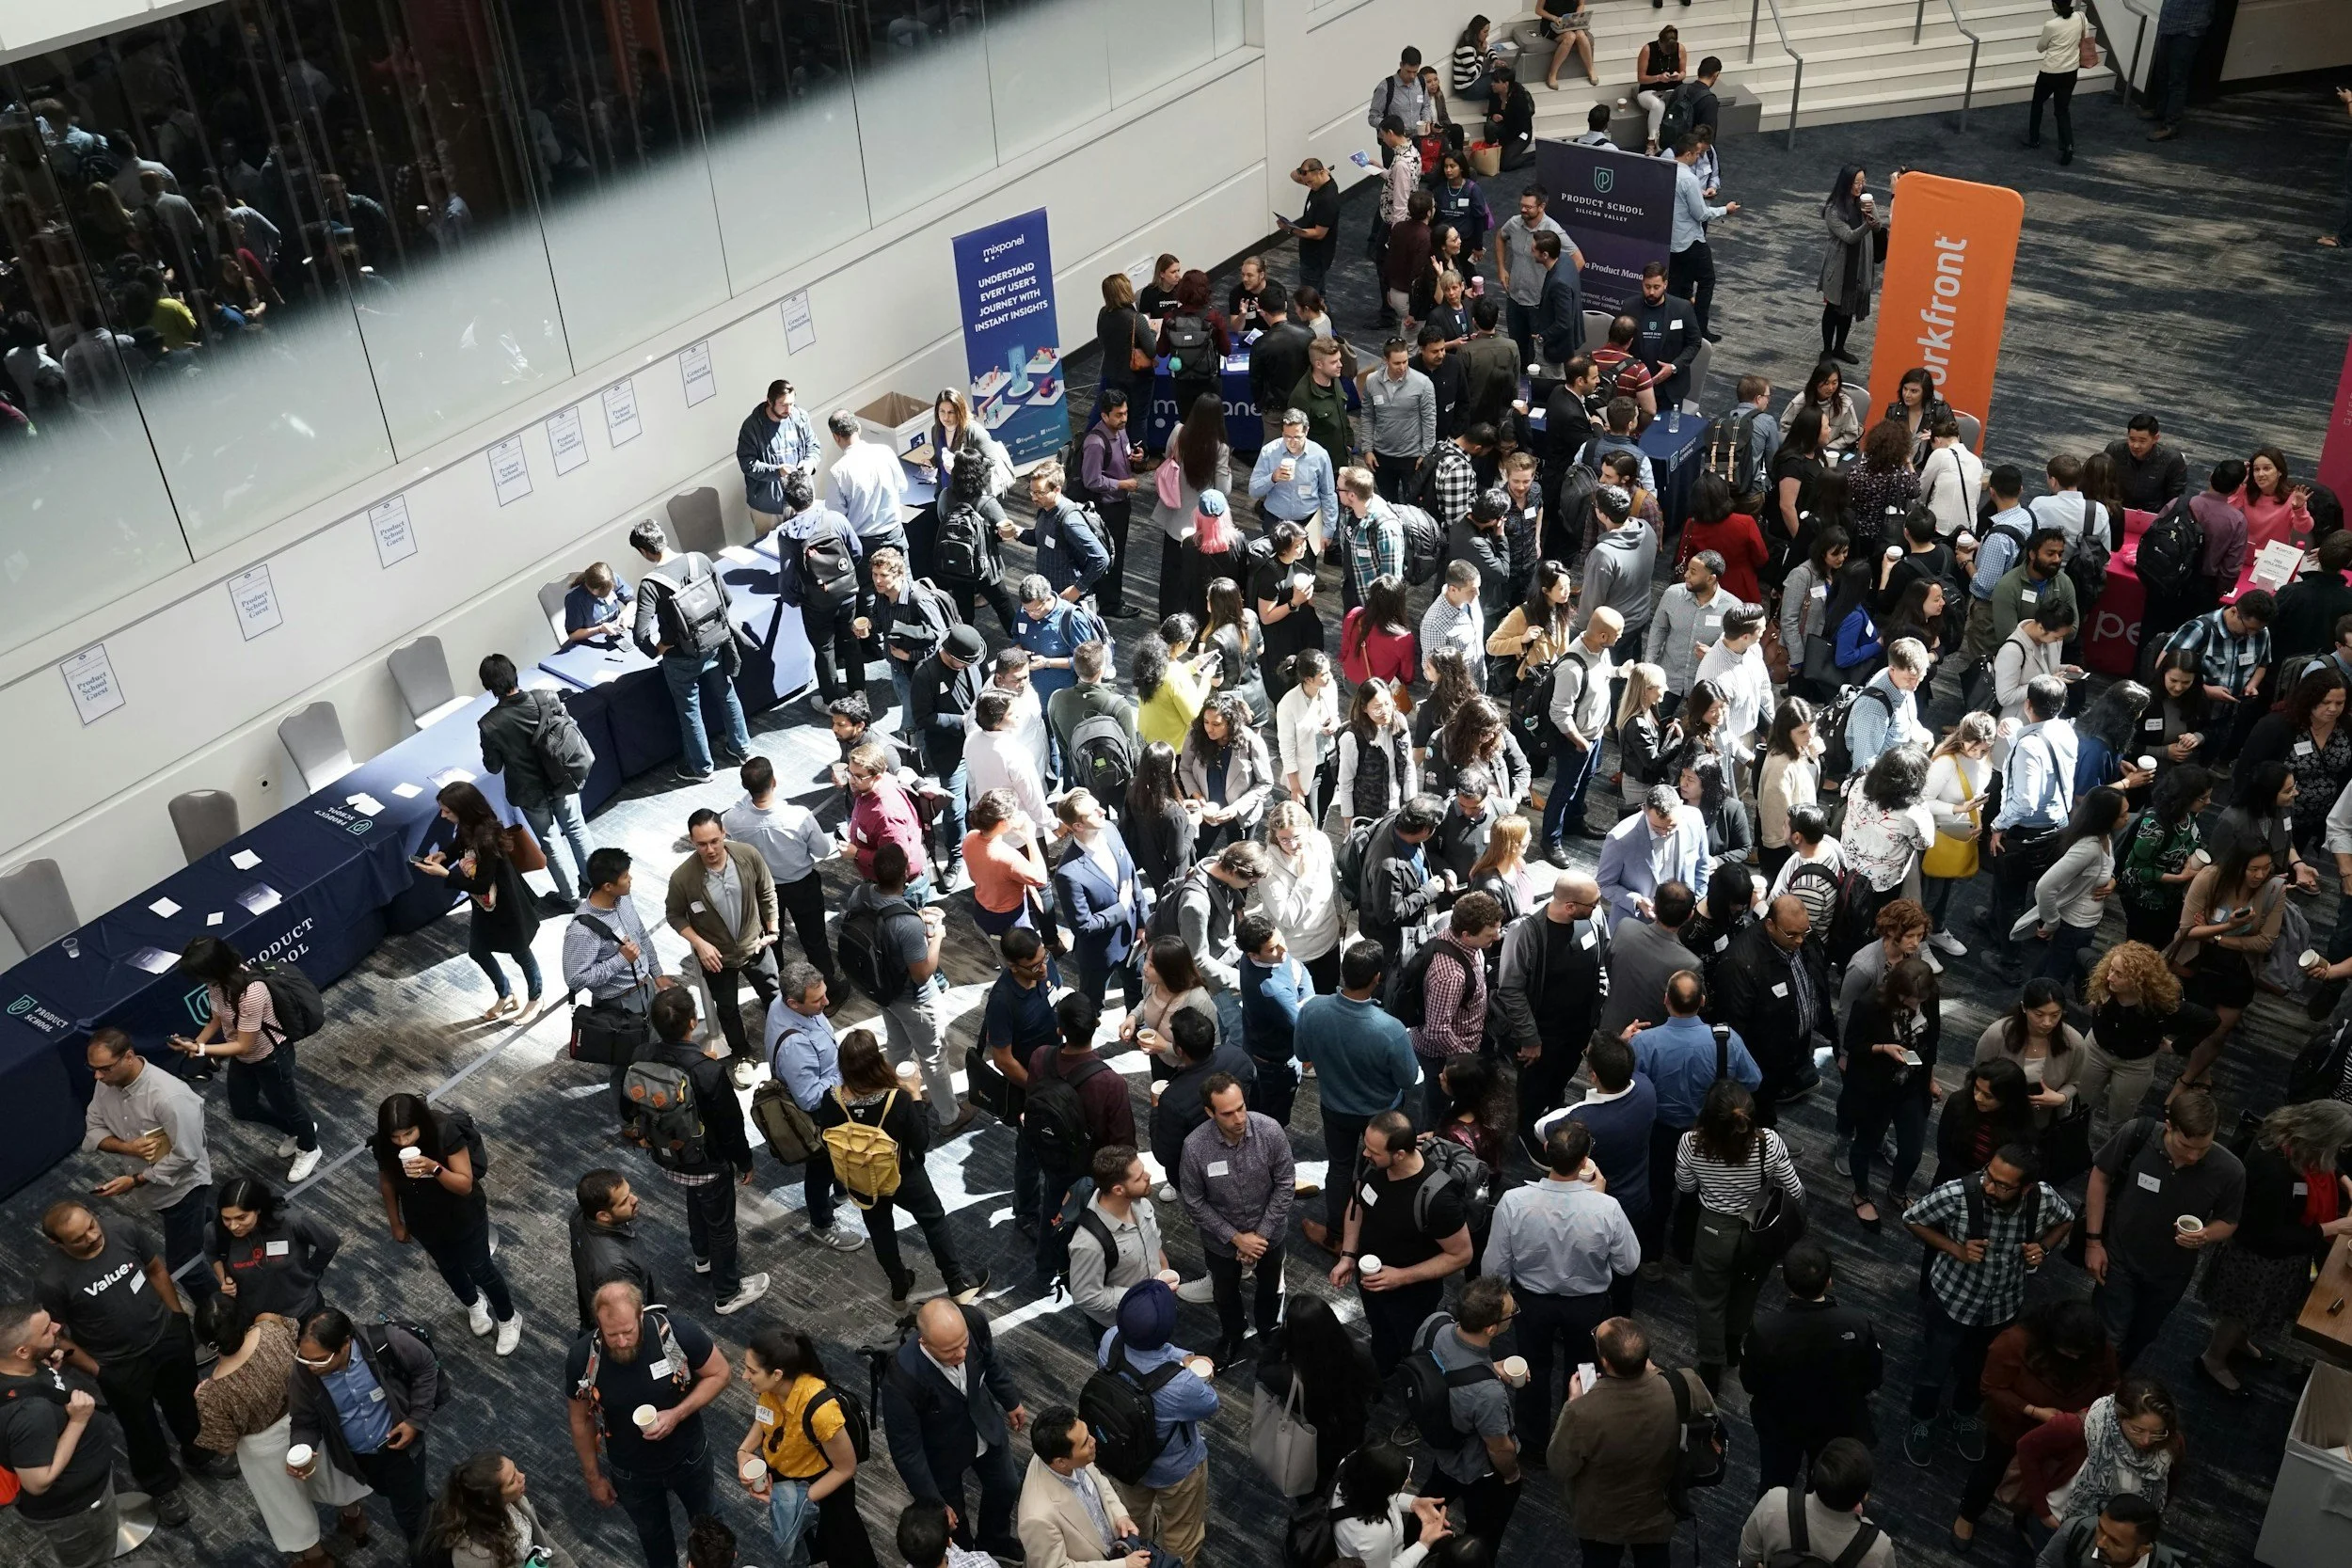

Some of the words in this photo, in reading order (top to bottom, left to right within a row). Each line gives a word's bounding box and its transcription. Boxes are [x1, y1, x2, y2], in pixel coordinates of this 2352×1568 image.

[1561, 192, 1604, 208] PRODUCT
[1607, 202, 1645, 215] SCHOOL
[1575, 207, 1601, 217] SILICON
[1604, 213, 1628, 222] VALLEY
[983, 234, 1025, 257] mixpanel
[978, 262, 1035, 288] UNDERSTAND
[1591, 262, 1620, 276] Product
[1621, 269, 1644, 280] Mana
[980, 286, 1007, 302] EVERY
[1008, 276, 1037, 292] USER'S
[979, 296, 1018, 317] JOURNEY
[1019, 288, 1041, 303] WITH
[975, 313, 1009, 332] INSTANT
[1010, 300, 1048, 319] INSIGHTS
[1917, 236, 1967, 401] orkfront
[500, 461, 519, 474] Product
[380, 520, 405, 536] Product
[383, 528, 405, 542] School
[386, 535, 405, 546] Guest
[241, 591, 268, 608] Product
[246, 598, 268, 613] School
[248, 606, 269, 619] Guest
[76, 672, 106, 690] Product
[82, 679, 107, 695] School
[87, 687, 108, 701] Guest
[314, 810, 348, 826] PRODUCT
[328, 806, 356, 821] SCHOOL
[246, 917, 313, 965] ODUCT
[24, 1014, 54, 1033] SCHOOL
[34, 1006, 69, 1028] PRODUCT
